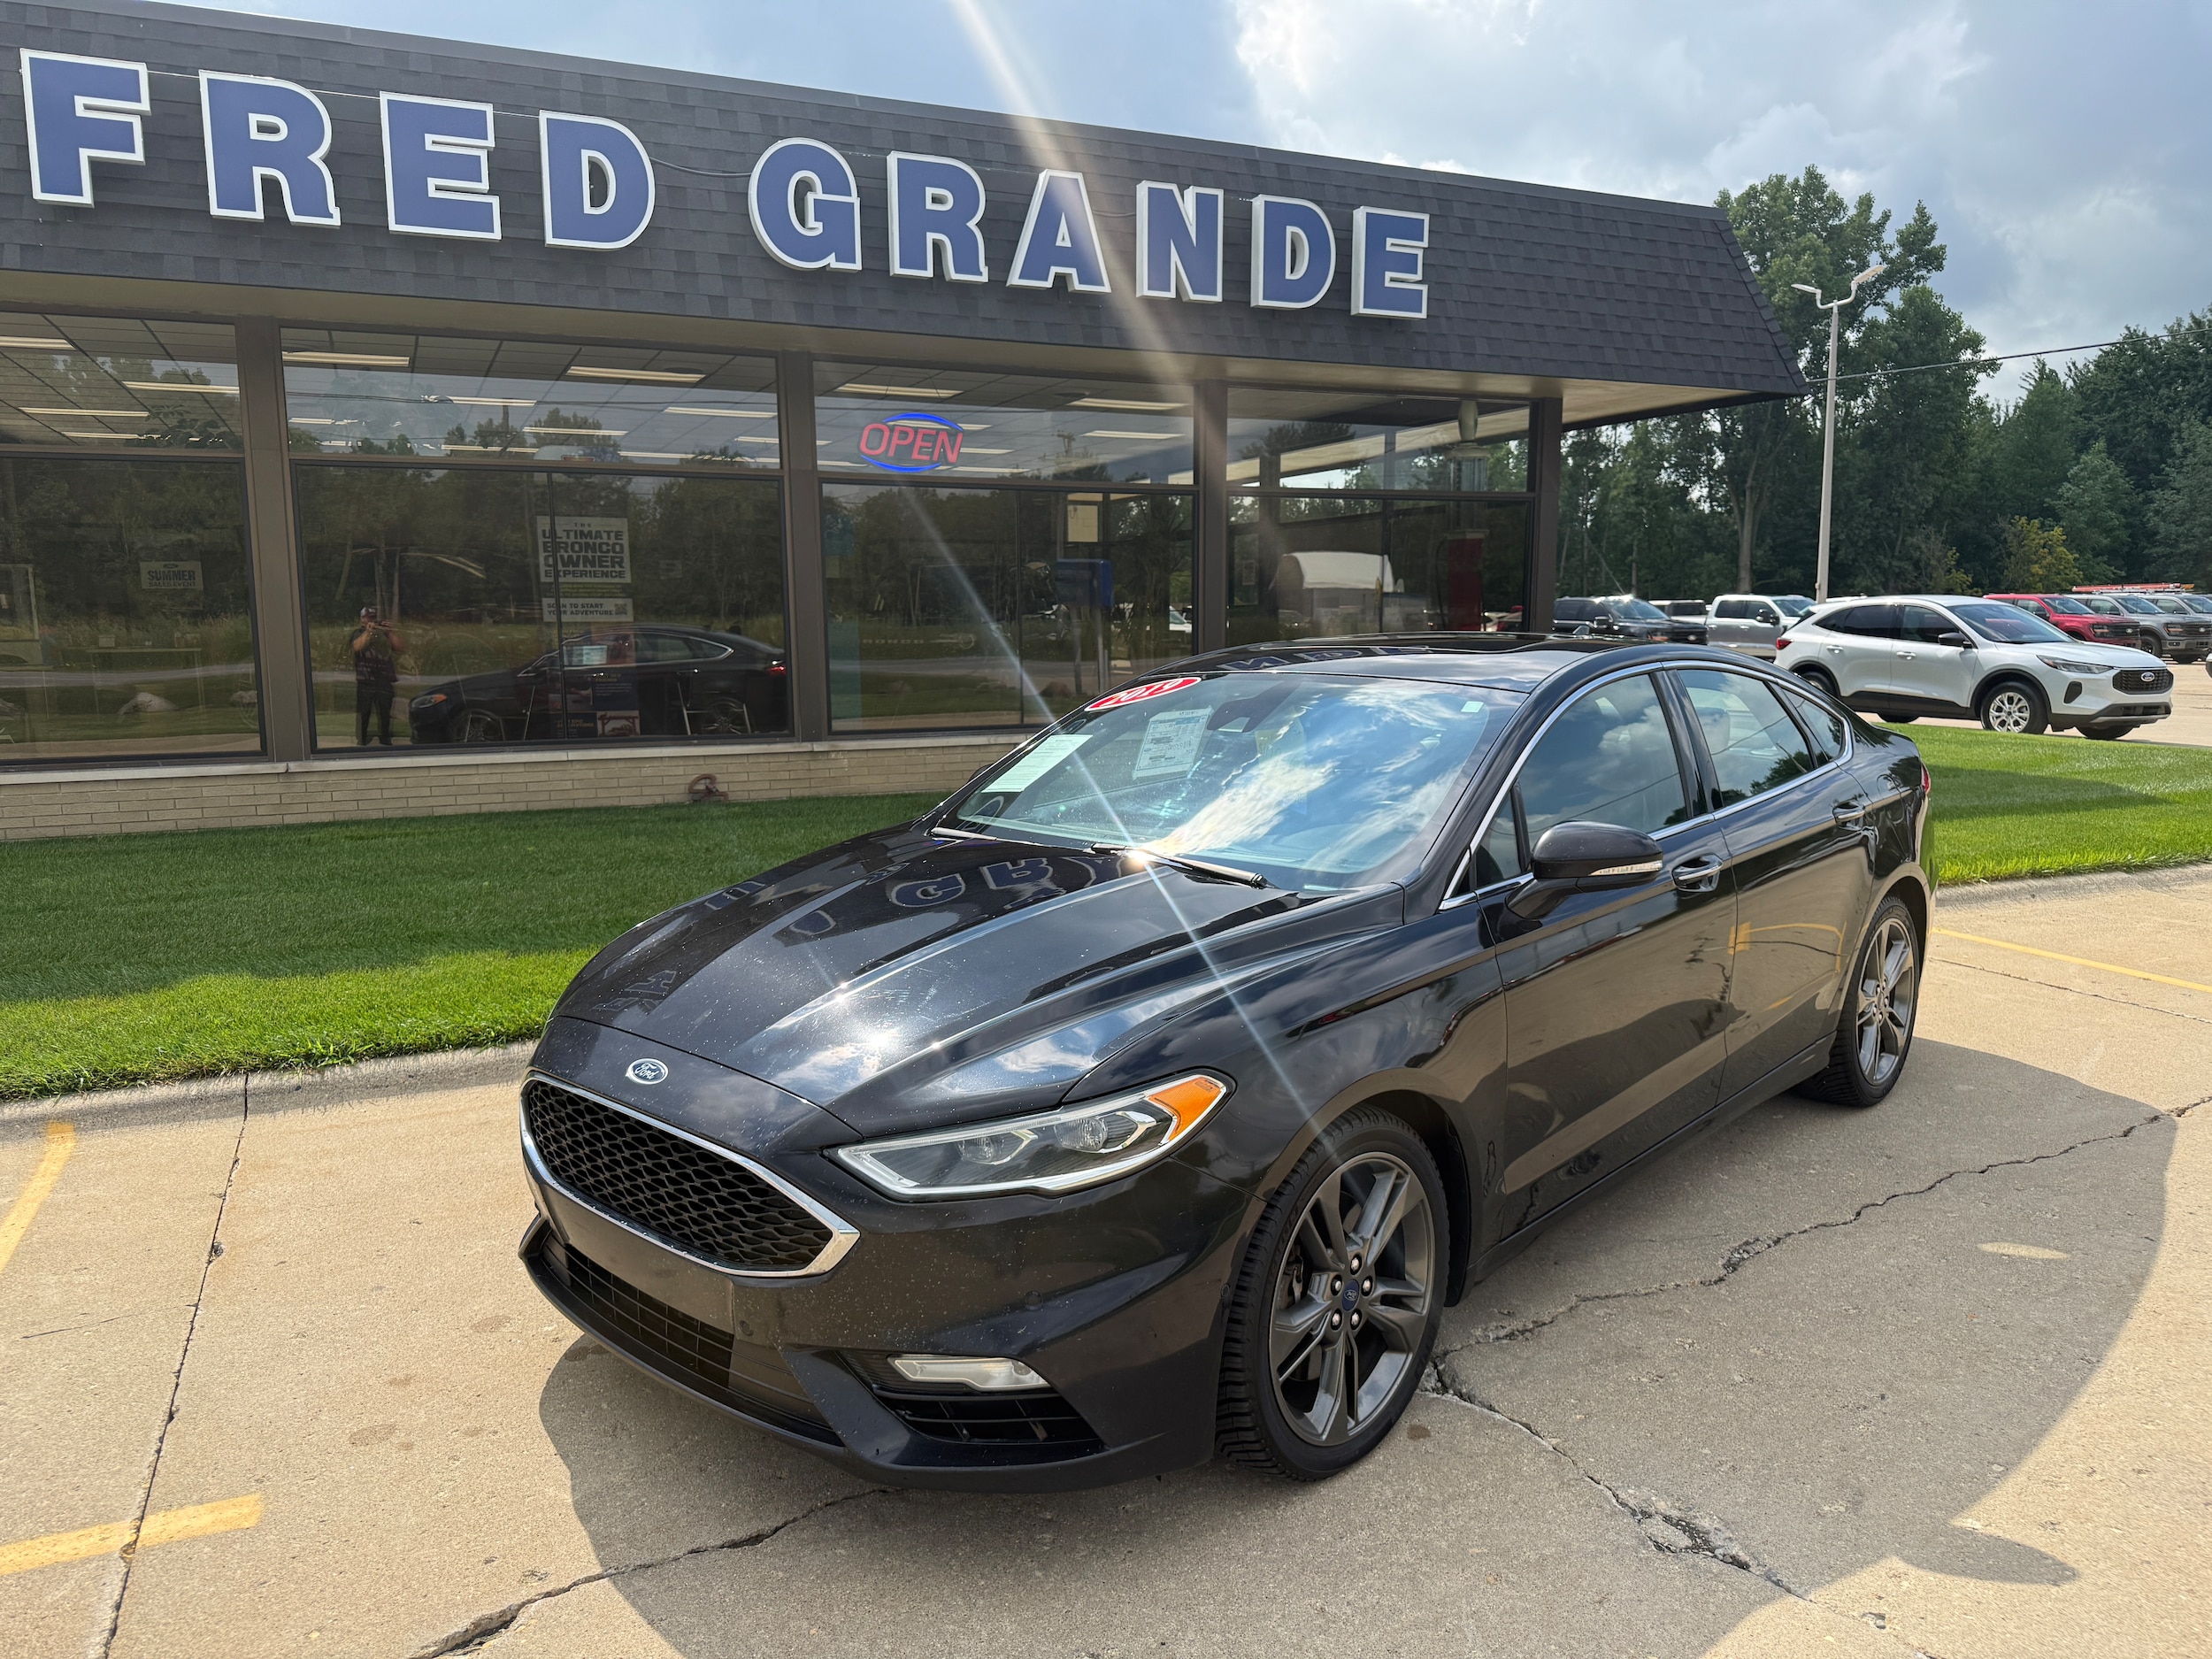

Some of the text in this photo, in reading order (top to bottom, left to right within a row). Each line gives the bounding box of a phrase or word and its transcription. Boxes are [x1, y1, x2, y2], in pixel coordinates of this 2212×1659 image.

[19, 48, 1431, 319] FRED GRANDE
[859, 422, 964, 464] OPEN
[541, 529, 624, 541] ULTIMATE
[542, 541, 625, 555] BRONCO
[543, 554, 625, 569] OWNER
[147, 570, 196, 581] SUMMER
[1098, 679, 1184, 708] 2019
